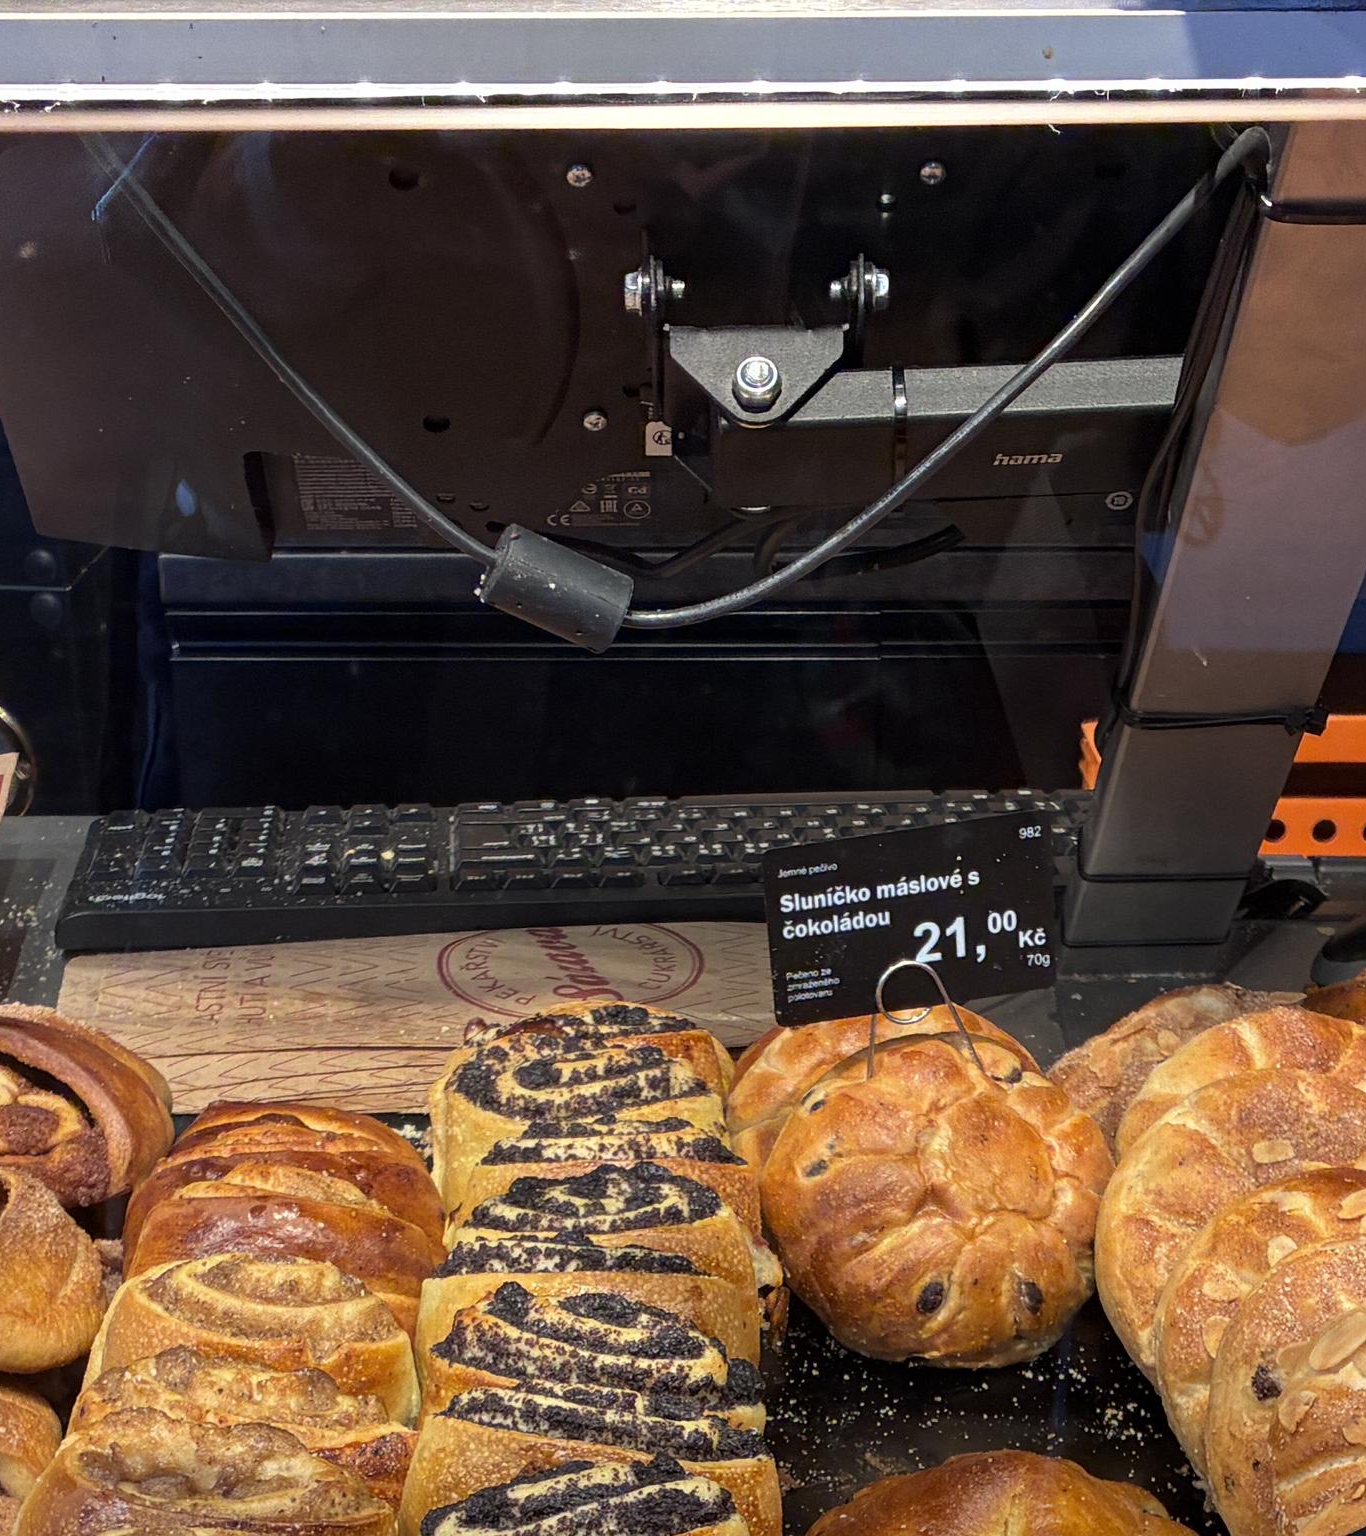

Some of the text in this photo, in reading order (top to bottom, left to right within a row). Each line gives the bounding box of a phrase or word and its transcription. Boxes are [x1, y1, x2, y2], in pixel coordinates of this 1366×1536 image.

[993, 453, 1063, 466] hama
[1018, 826, 1042, 839] 982
[780, 869, 980, 913] Sluníčko máslové s
[782, 909, 891, 940] čokoládou
[1018, 928, 1047, 949] Kč
[1026, 953, 1051, 968] 70g
